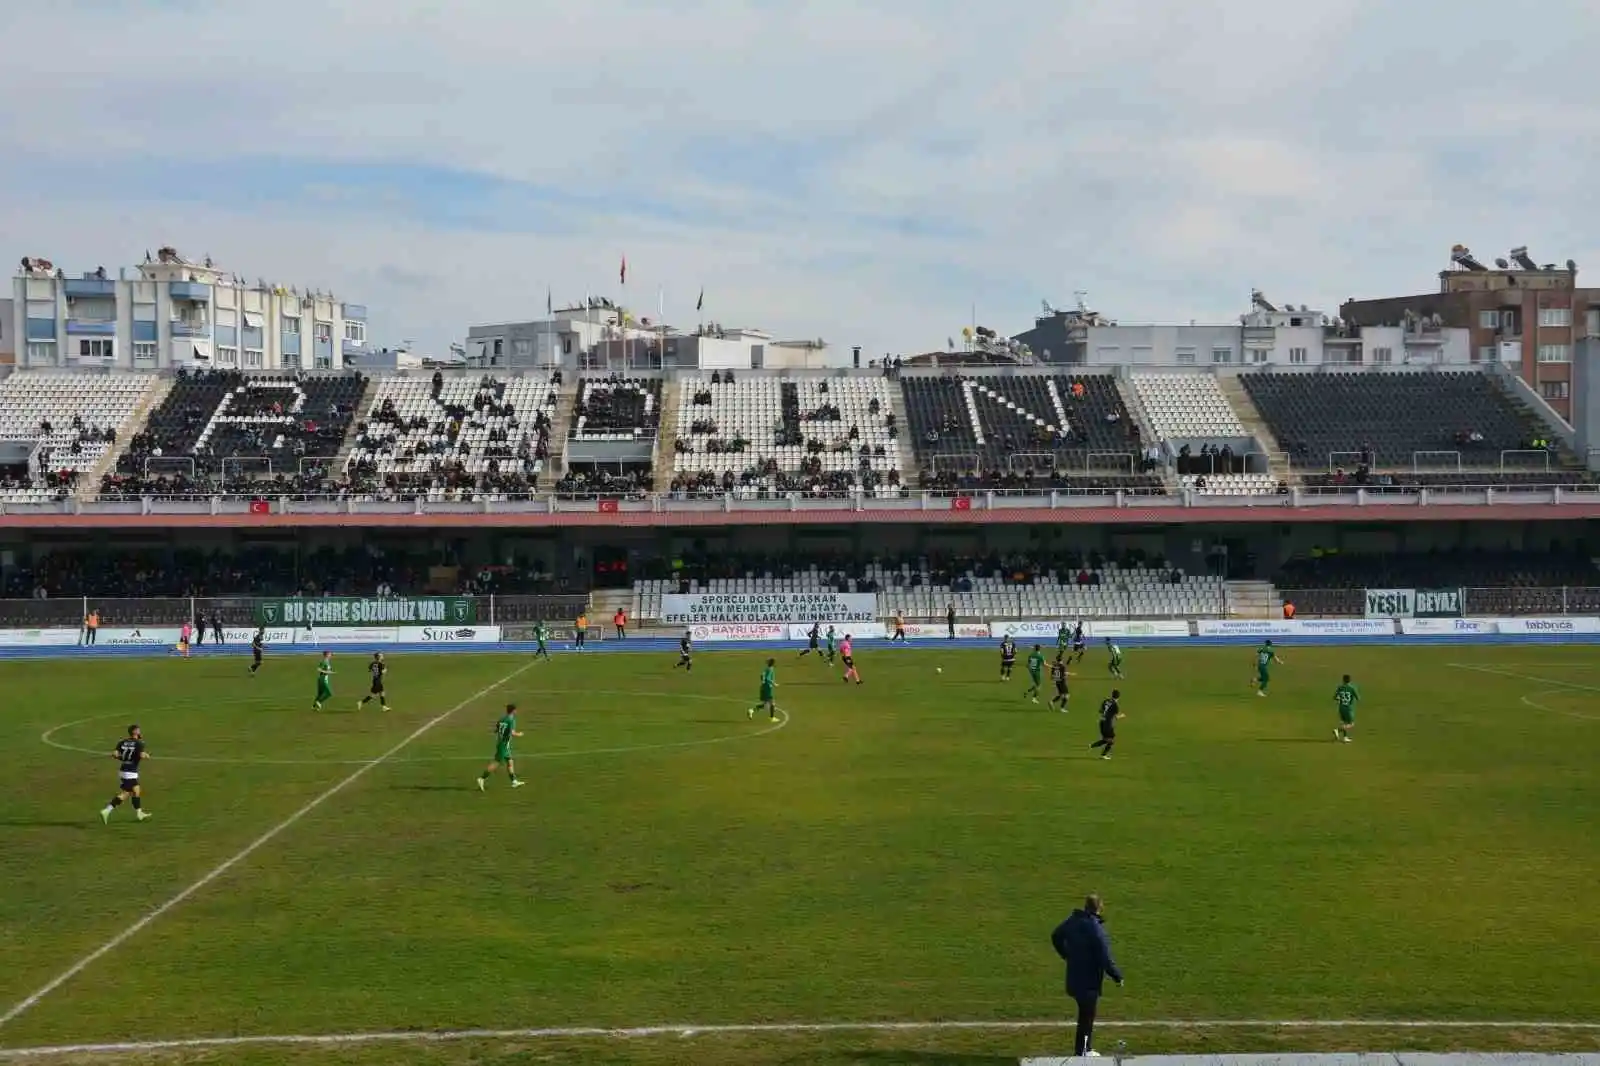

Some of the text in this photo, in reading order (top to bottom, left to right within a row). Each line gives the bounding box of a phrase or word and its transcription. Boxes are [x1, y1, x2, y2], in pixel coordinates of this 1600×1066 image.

[702, 595, 745, 604] SPORCU
[750, 595, 786, 603] DOSTU
[284, 601, 304, 622] BU
[352, 598, 415, 622] SÖZÜMÜZ
[418, 600, 445, 621] VAR
[690, 604, 722, 613] SAYIN
[727, 604, 771, 613] MEHMET
[666, 614, 706, 622] EFELER
[748, 613, 792, 622] OLARAK
[750, 624, 781, 633] USTA
[1340, 691, 1351, 702] 33
[120, 745, 136, 761] 77
